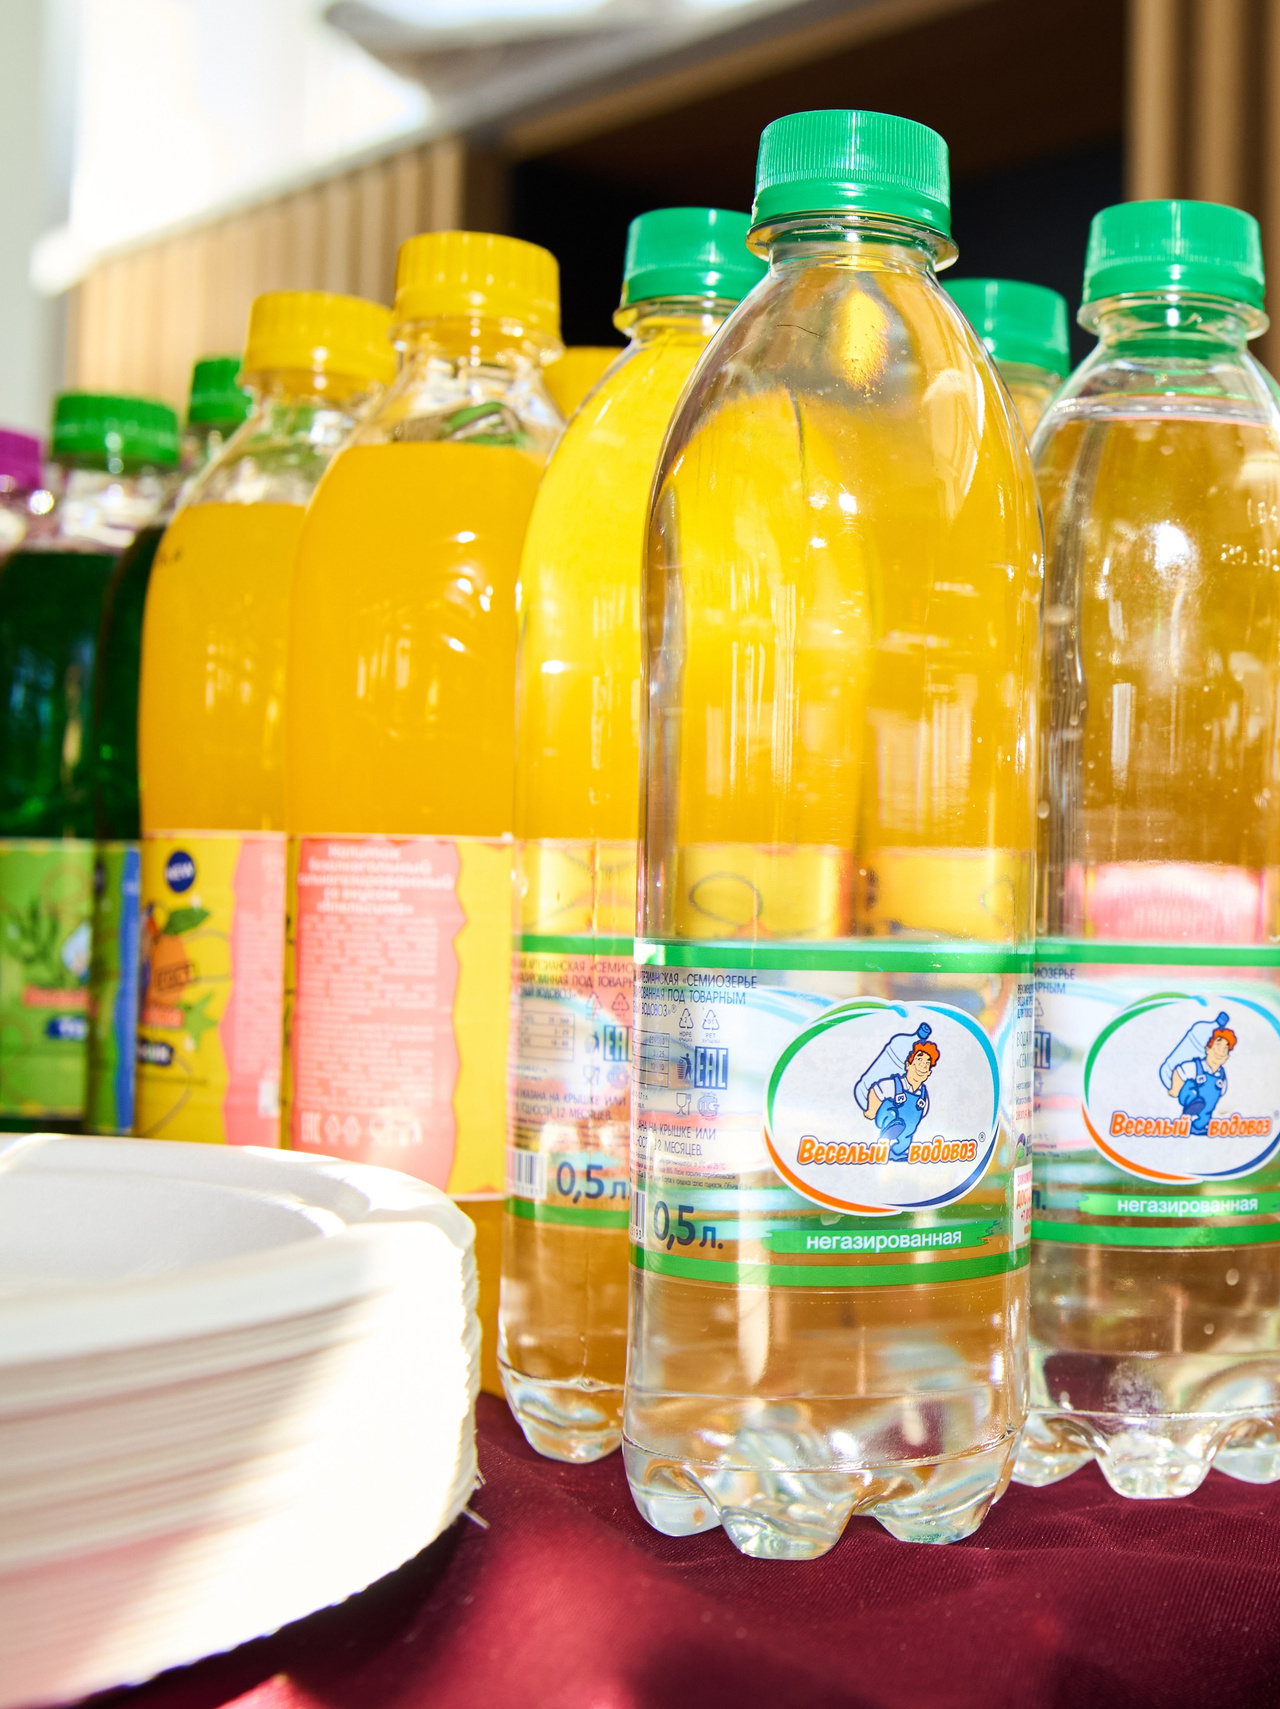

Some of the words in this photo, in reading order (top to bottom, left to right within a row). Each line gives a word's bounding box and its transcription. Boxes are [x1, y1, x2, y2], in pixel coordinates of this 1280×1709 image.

[1034, 967, 1075, 980] ИОЗЕРЬЕ
[667, 988, 686, 1004] ПОД
[690, 989, 747, 1005] ТОВАРНЫМ
[659, 1124, 692, 1139] КРЫШКЕ
[695, 1127, 716, 1141] ИЛИ
[1110, 1110, 1191, 1138] Веселый
[1207, 1112, 1272, 1138] водовоз
[798, 1135, 889, 1165] Веселый
[908, 1135, 978, 1164] водовоз
[557, 1161, 604, 1204] 0,5
[1117, 1197, 1258, 1217] негазированная
[654, 1200, 696, 1250] 0,5
[699, 1226, 724, 1250] л.
[806, 1231, 962, 1253] негазированная
